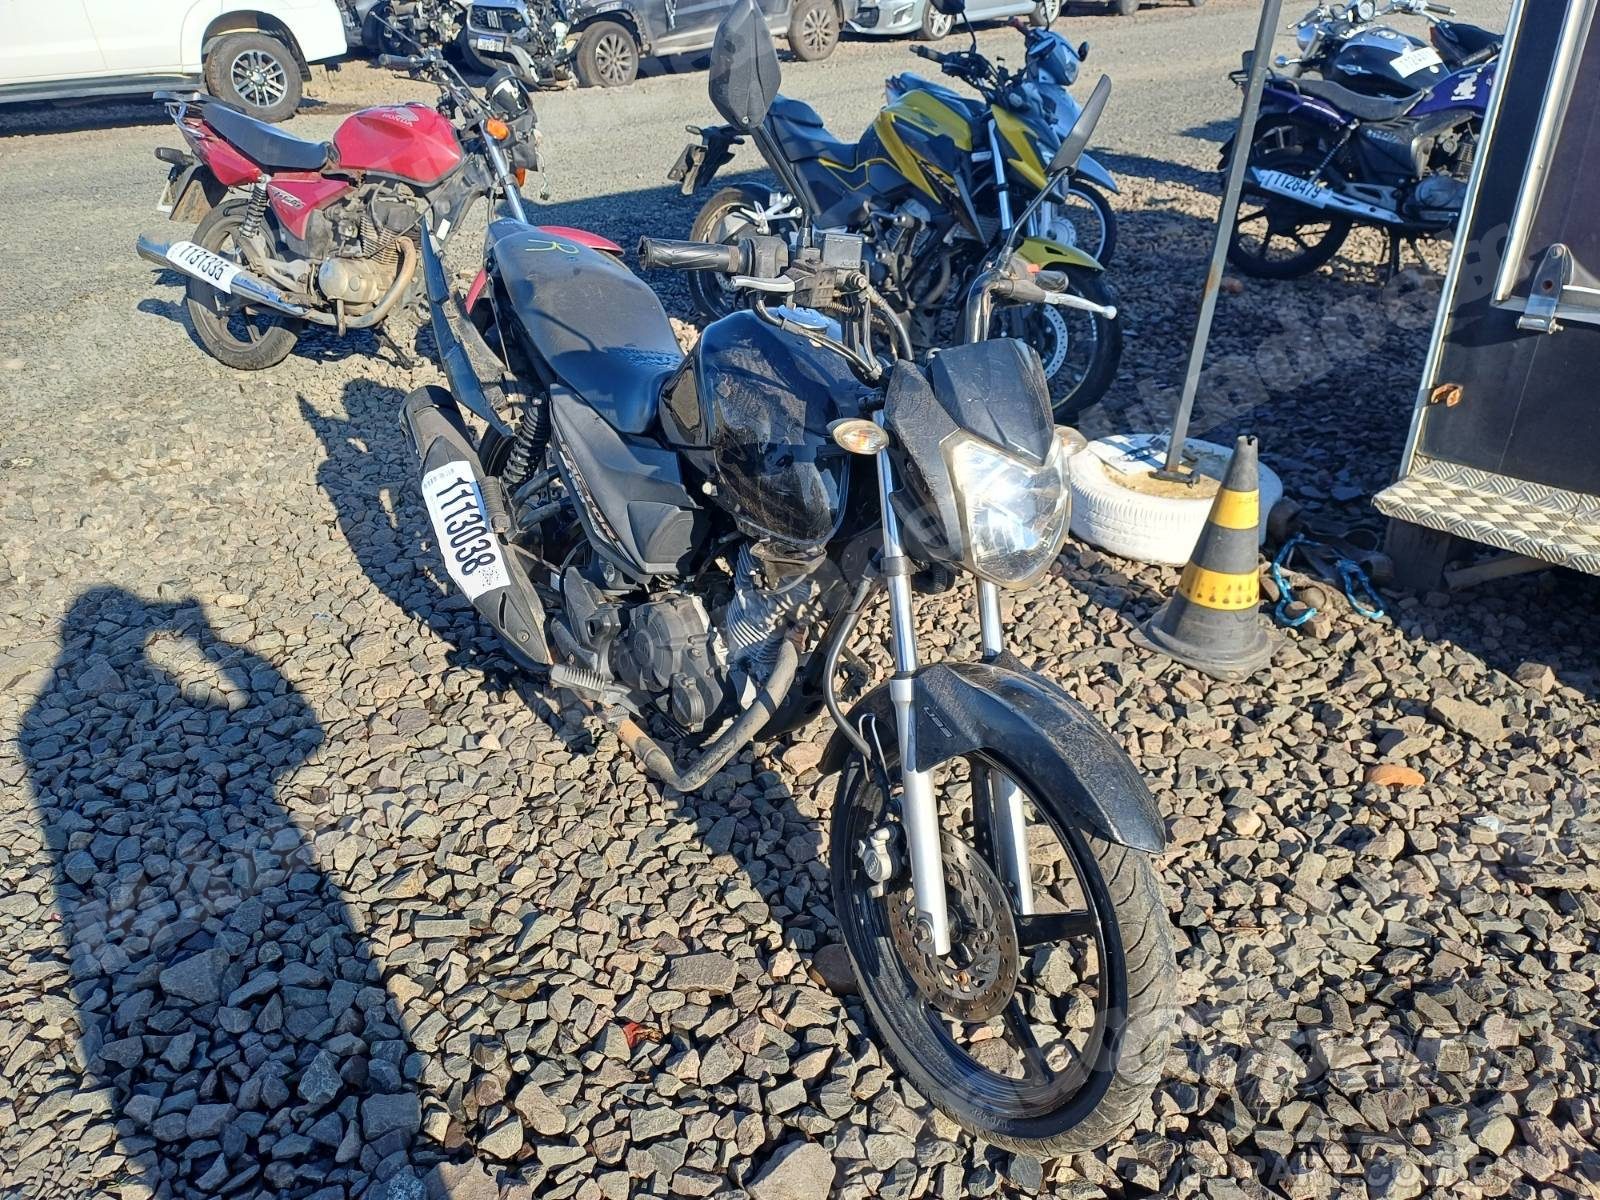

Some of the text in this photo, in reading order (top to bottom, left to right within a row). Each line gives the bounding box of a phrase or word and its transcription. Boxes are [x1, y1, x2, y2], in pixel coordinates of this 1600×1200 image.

[178, 244, 230, 281] 1131335
[436, 477, 496, 576] 1113038
[560, 443, 616, 540] FACTOR
